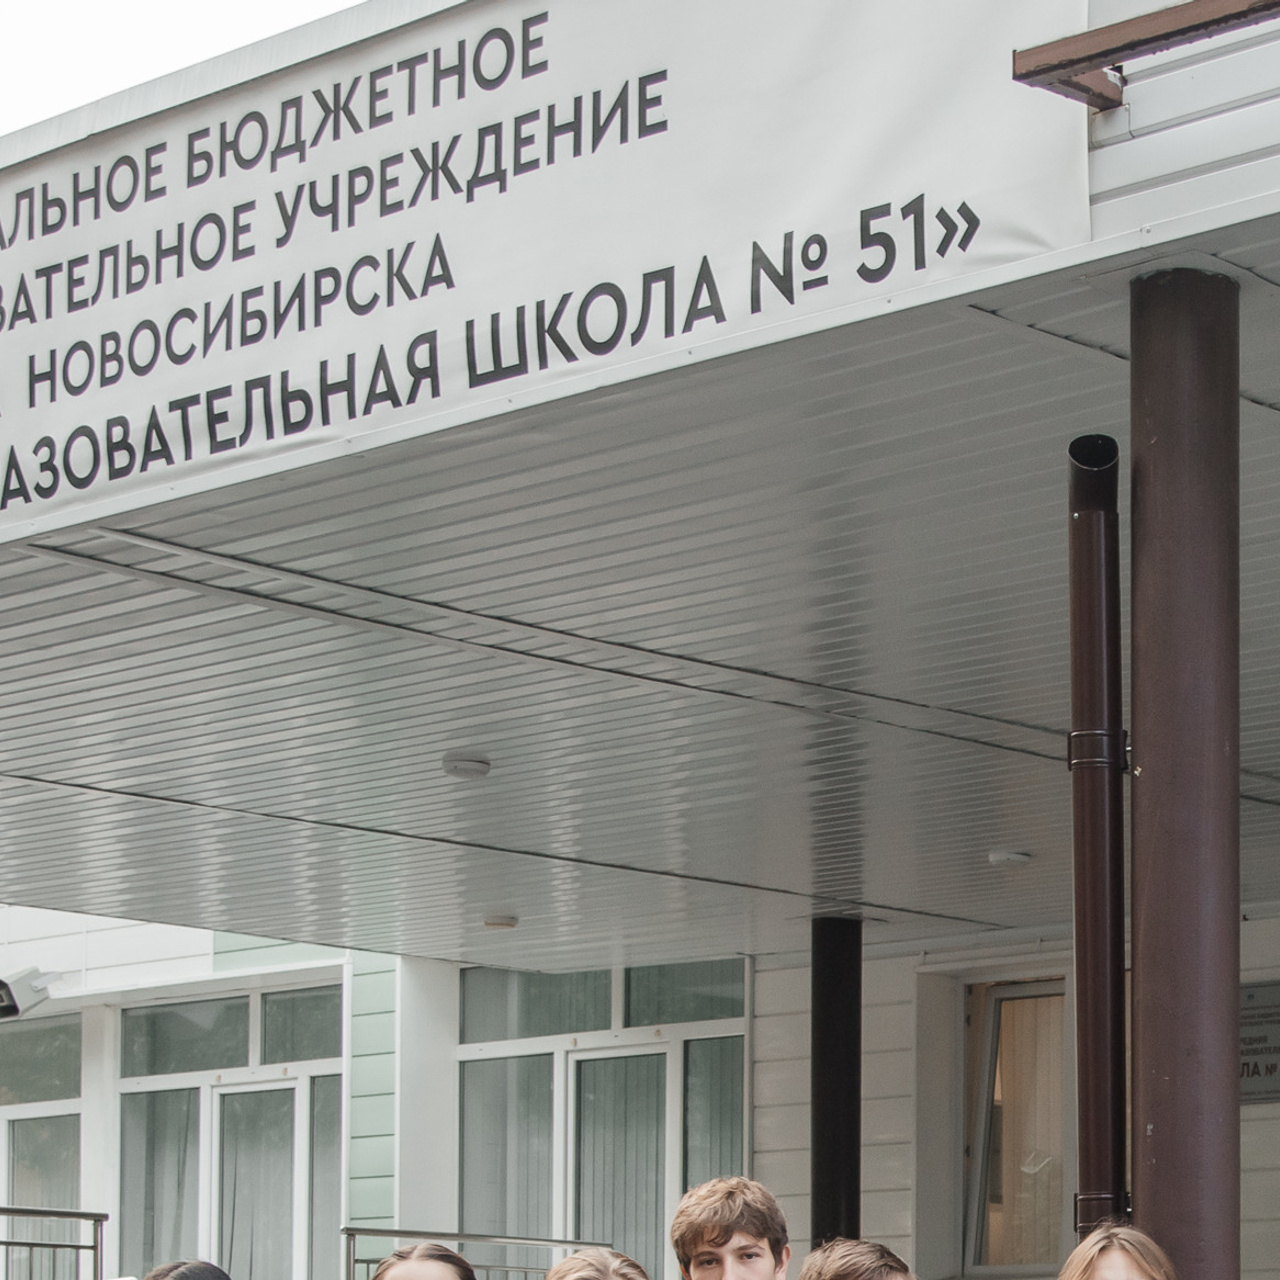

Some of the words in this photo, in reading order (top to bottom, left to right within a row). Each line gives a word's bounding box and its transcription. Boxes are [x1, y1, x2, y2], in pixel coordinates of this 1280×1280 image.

[0, 142, 167, 250] ЛЬНОЕ
[187, 11, 549, 188] БЮДЖЕТНОЕ
[0, 200, 257, 333] АТЕЛЬНОЕ
[275, 69, 668, 249] УЧРЕЖДЕНИЕ
[0, 330, 441, 510] АЗОВАТЕЛЬНАЯ
[466, 255, 727, 390] ШКОЛА
[751, 230, 829, 314] №
[856, 193, 981, 284] 51»
[28, 233, 456, 409] НОВОСИБИРСКА
